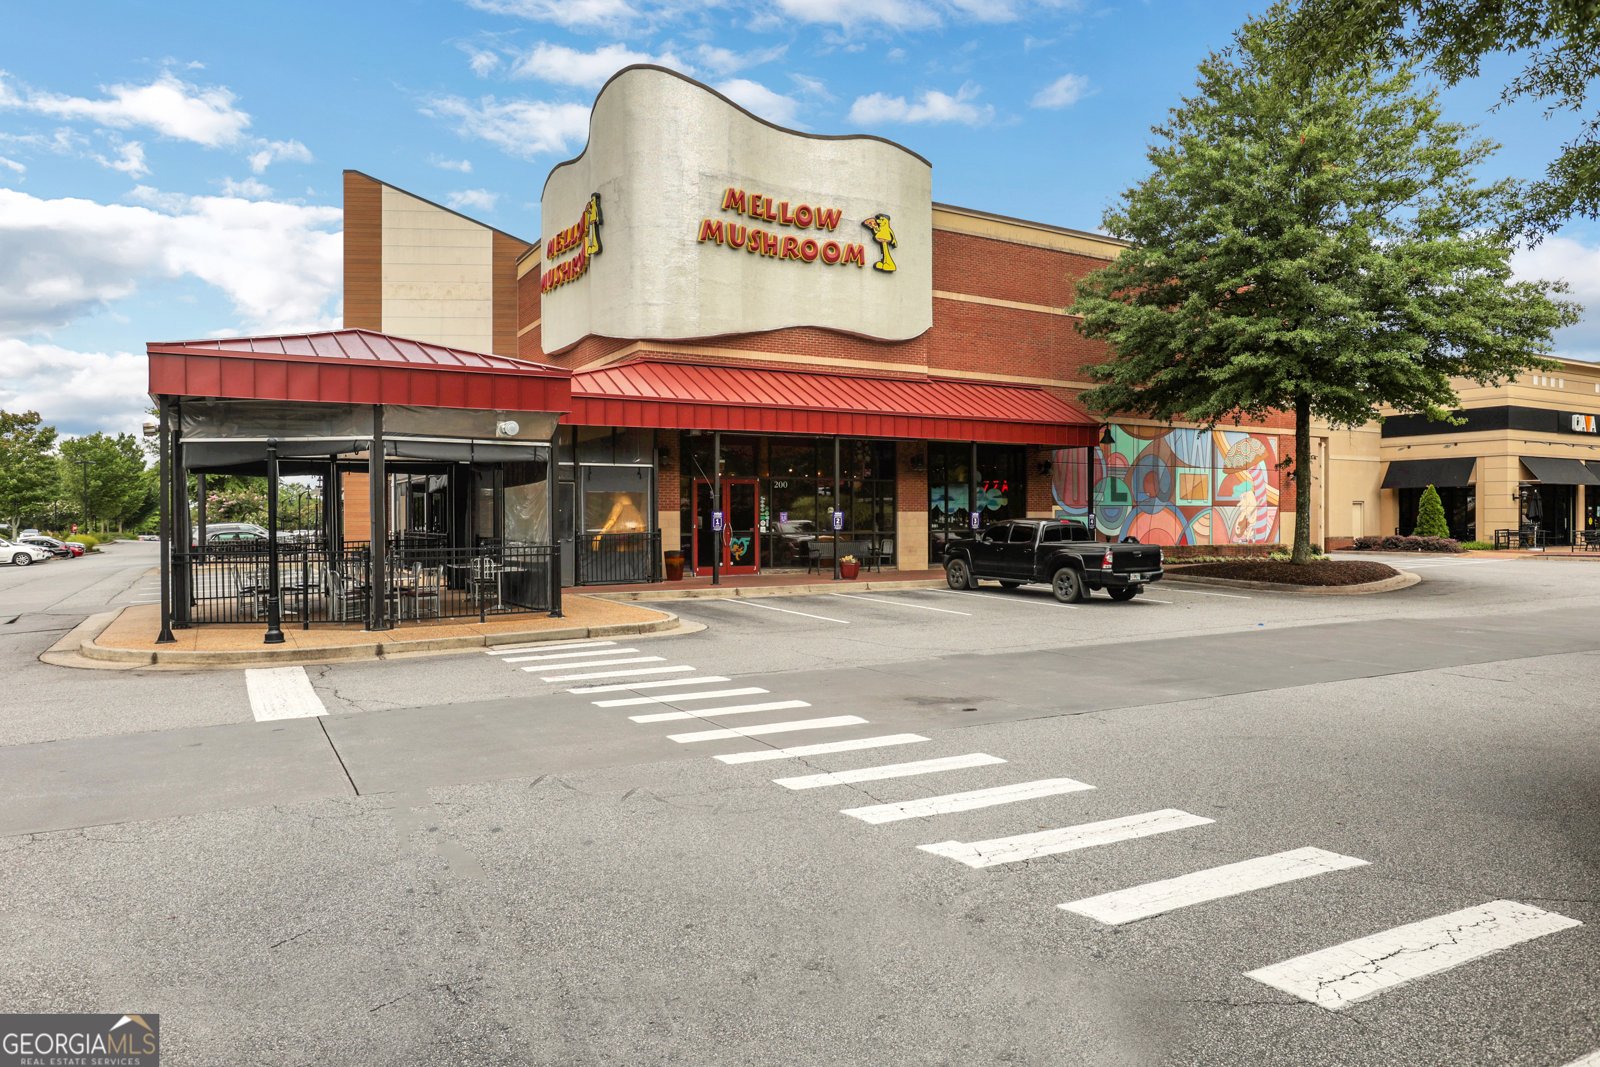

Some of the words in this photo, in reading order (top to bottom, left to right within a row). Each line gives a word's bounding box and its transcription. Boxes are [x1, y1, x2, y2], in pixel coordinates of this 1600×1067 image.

[722, 187, 842, 231] MELLOW
[698, 218, 865, 267] MUSHROOM
[1571, 414, 1597, 433] CAVA
[773, 480, 789, 489] 200
